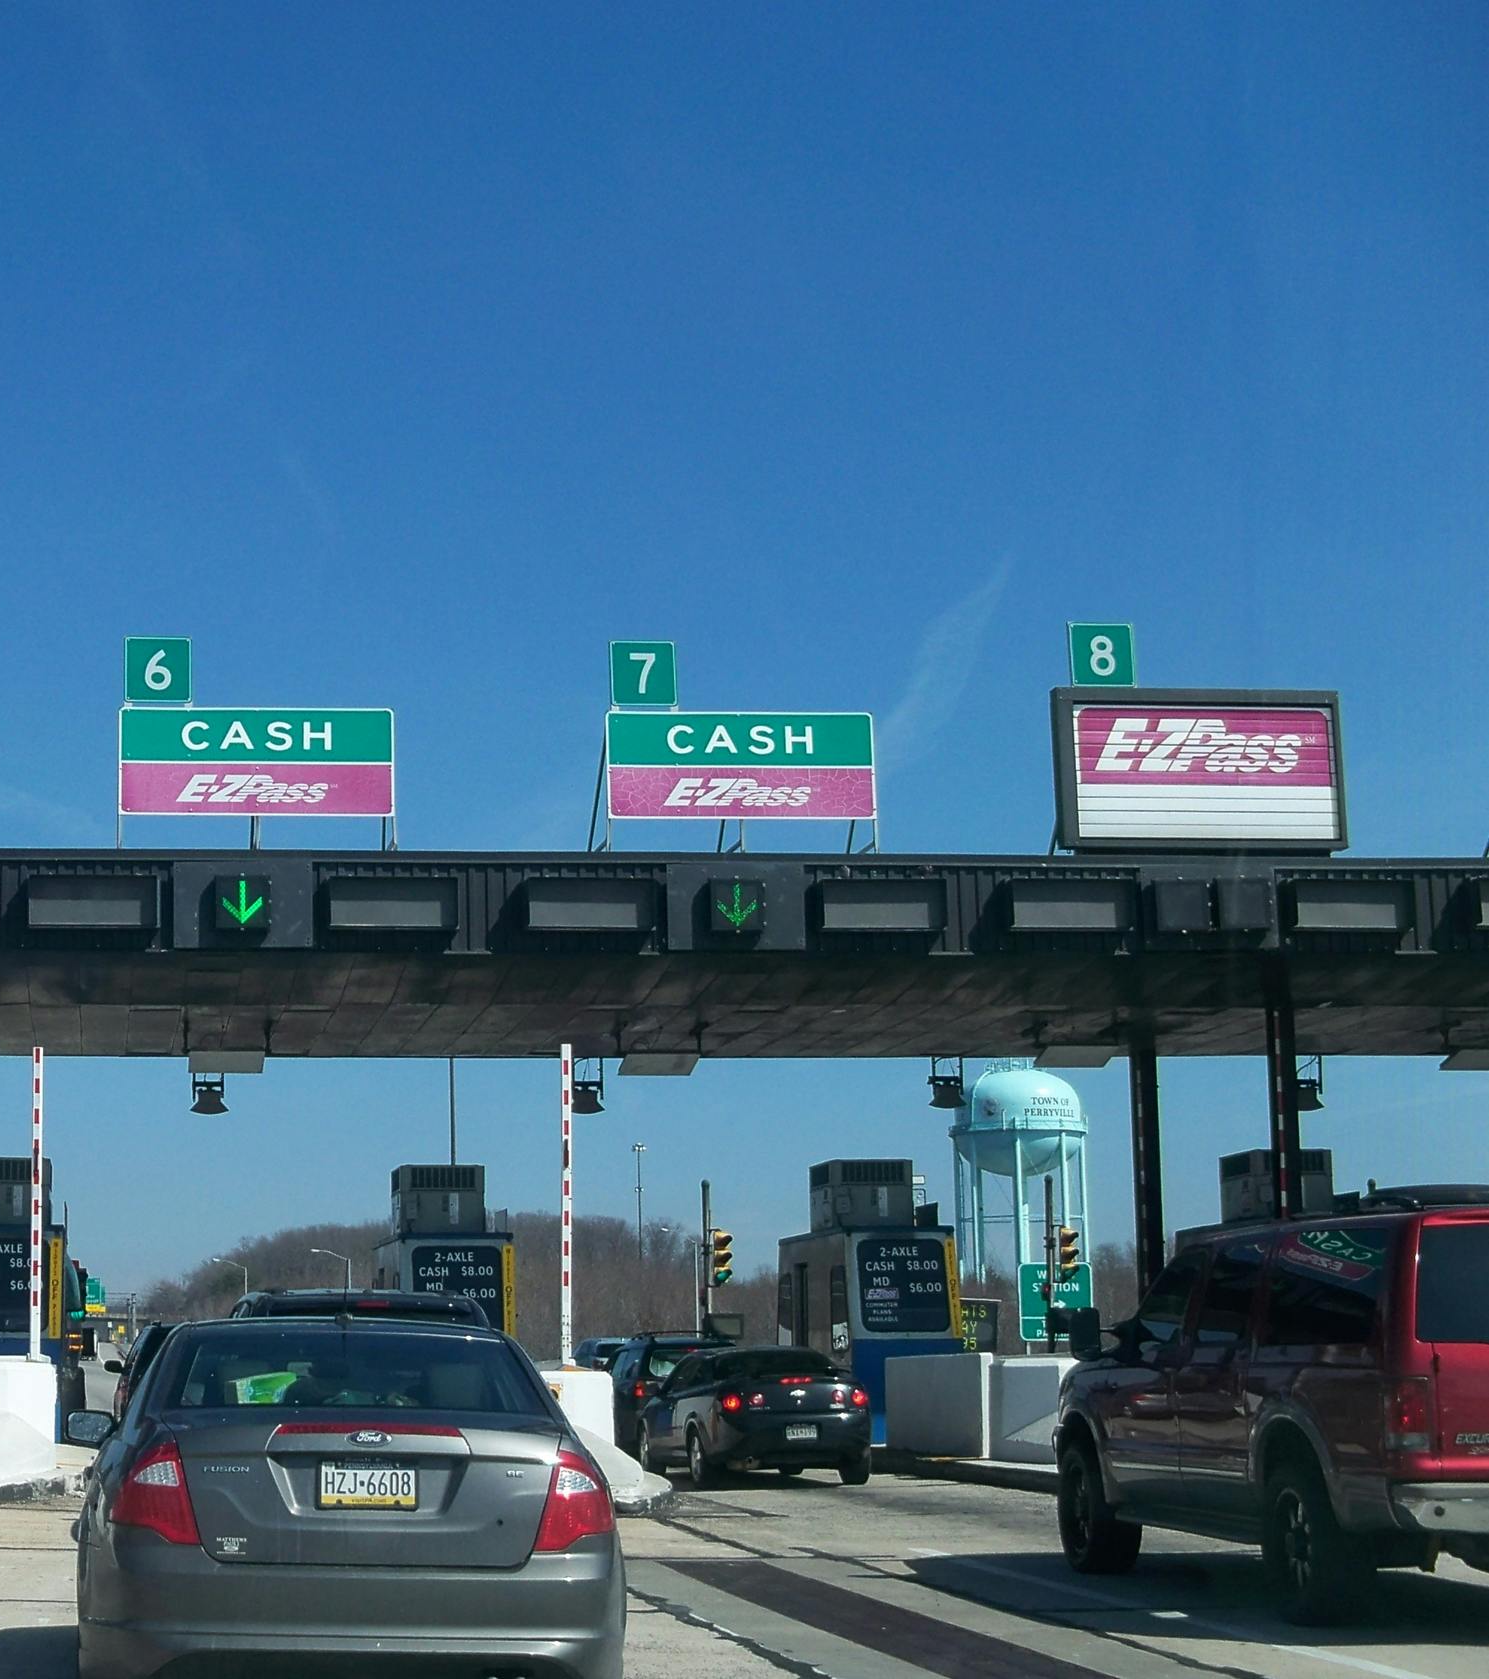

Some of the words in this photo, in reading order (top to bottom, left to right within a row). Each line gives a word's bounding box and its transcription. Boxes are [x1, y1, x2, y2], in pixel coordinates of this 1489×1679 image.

[1090, 635, 1116, 676] 8
[144, 649, 172, 691] 6
[629, 652, 656, 694] 7
[181, 720, 332, 751] CASH
[666, 724, 814, 754] CASH
[1030, 1097, 1058, 1105] TOWN
[434, 1252, 474, 1262] 2-AXLE
[879, 1246, 919, 1257] 2-AXLE
[419, 1266, 449, 1277] CASH
[461, 1265, 494, 1276] $8.00
[865, 1261, 895, 1271] CASH
[906, 1260, 938, 1271] $8.00
[872, 1276, 890, 1286] MD
[462, 1288, 496, 1298] $6.00
[909, 1282, 942, 1293] $6.00
[1032, 1283, 1080, 1292] STION
[356, 1431, 382, 1443] Ford
